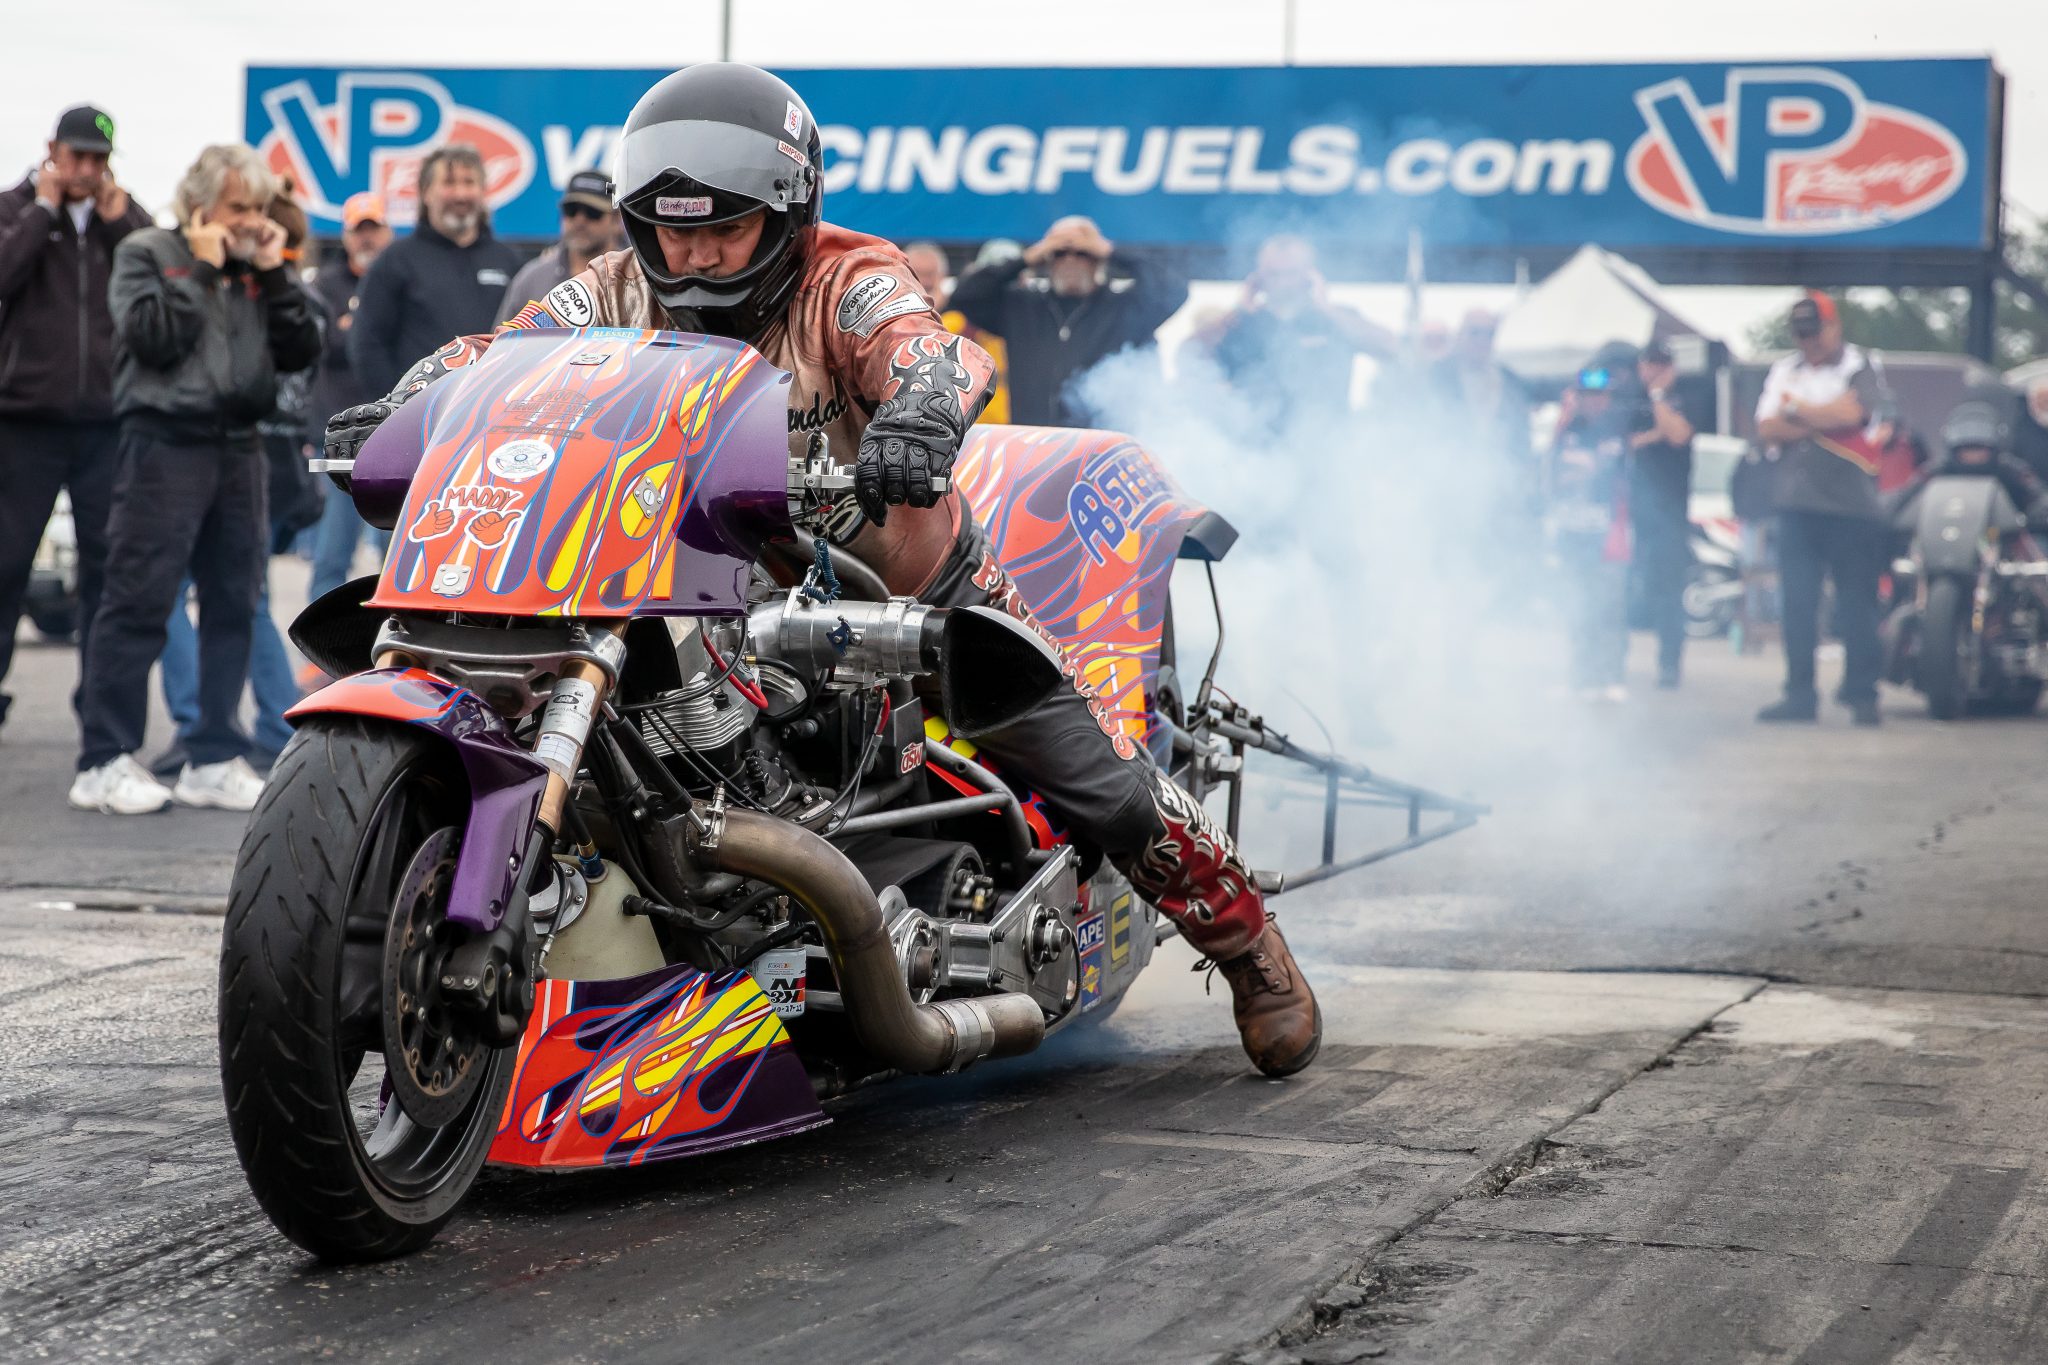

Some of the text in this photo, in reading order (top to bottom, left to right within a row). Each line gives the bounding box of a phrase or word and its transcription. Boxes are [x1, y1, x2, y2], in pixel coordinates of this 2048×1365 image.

[262, 73, 452, 212] VP
[780, 142, 804, 164] SIMPSON
[1634, 67, 1864, 222] VP
[592, 330, 636, 339] BLESSED
[444, 486, 521, 512] MADDY
[1080, 919, 1103, 949] APE
